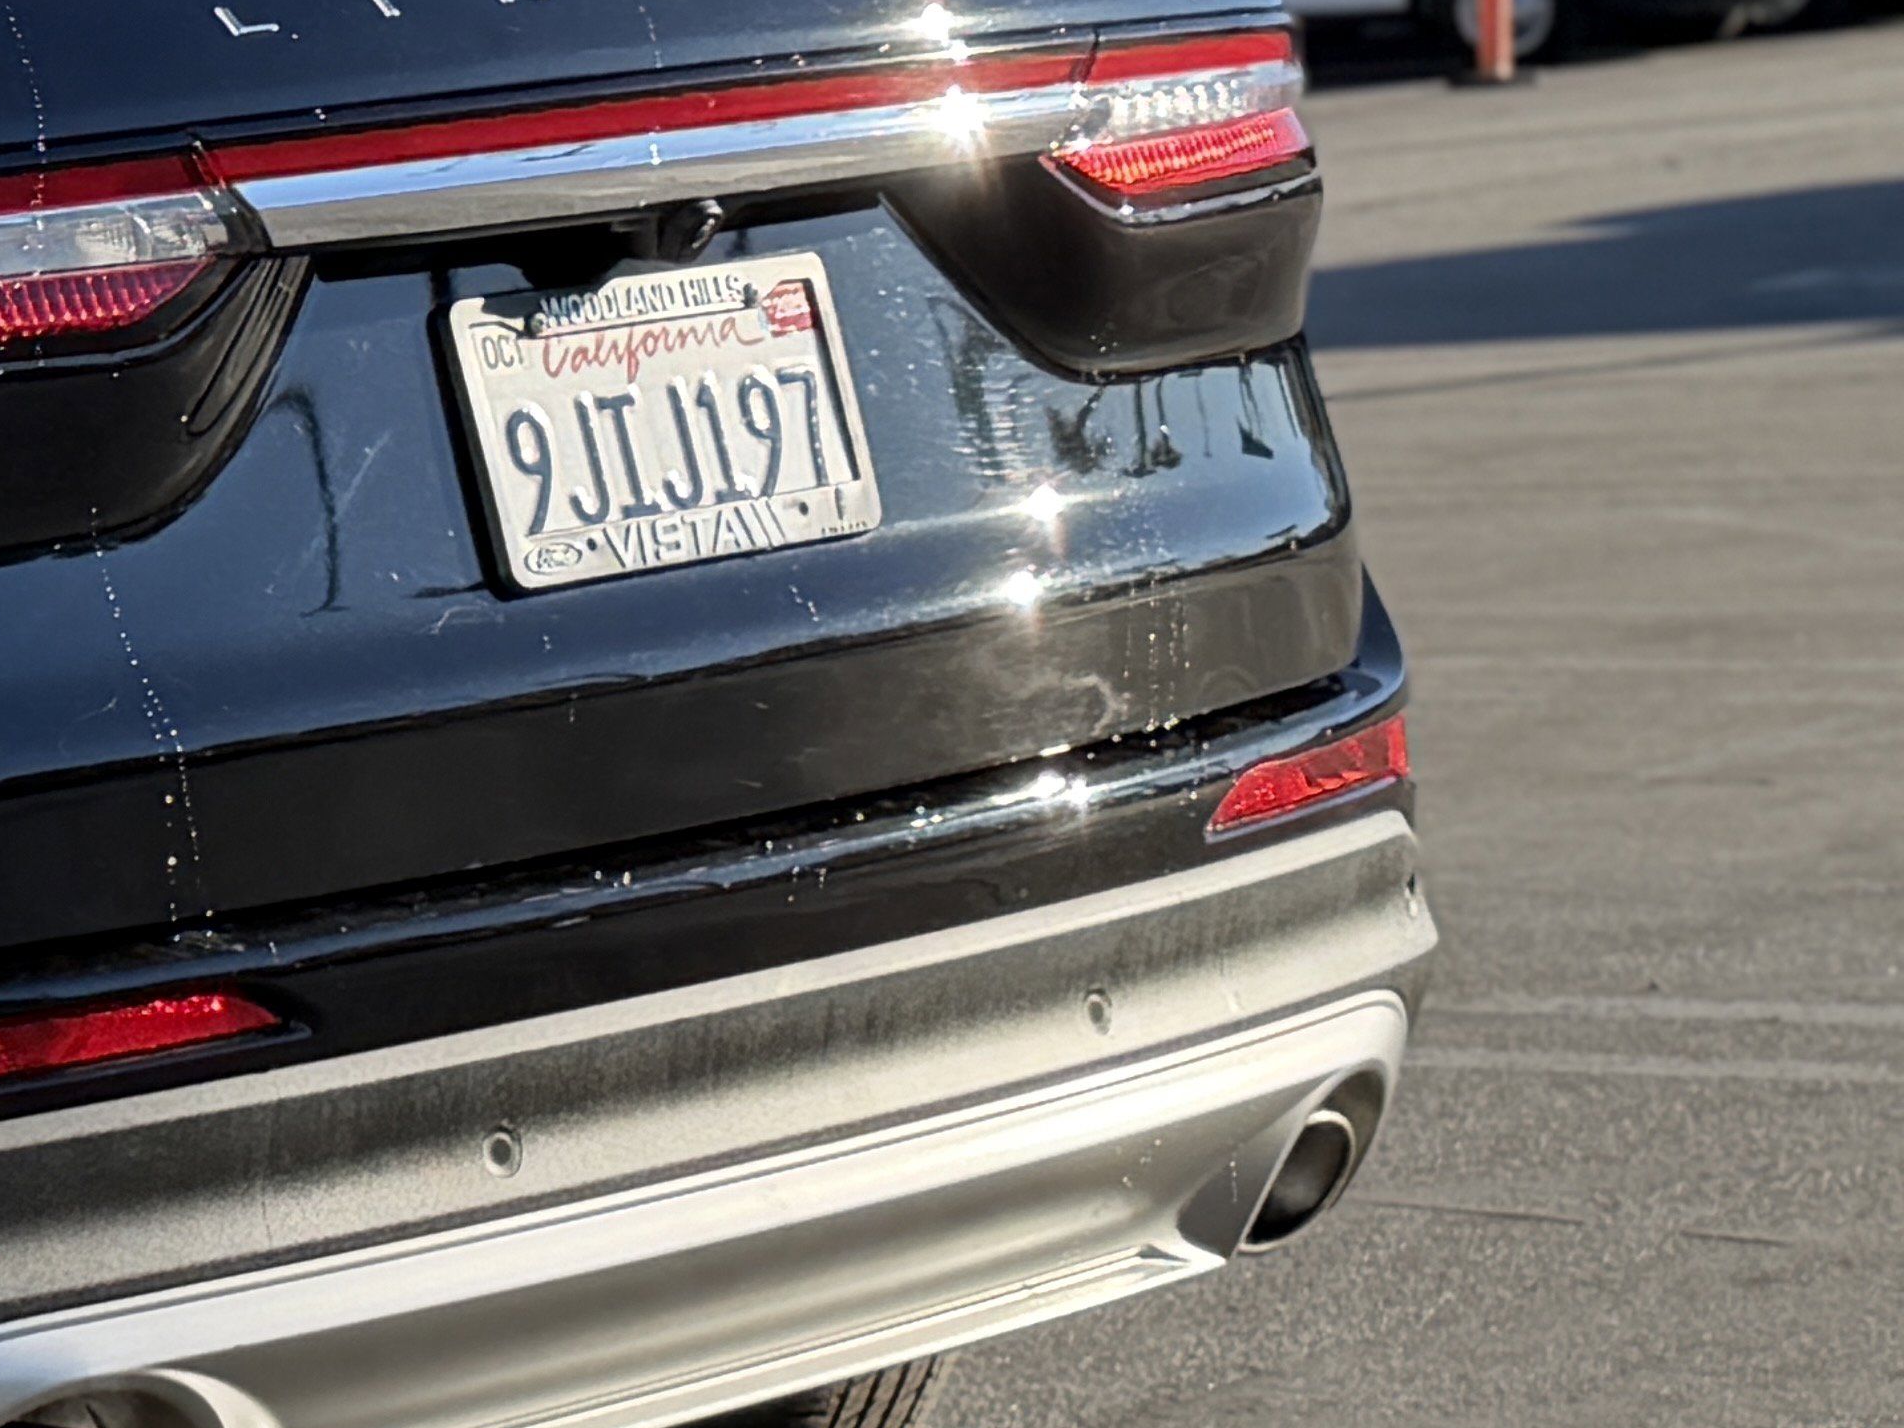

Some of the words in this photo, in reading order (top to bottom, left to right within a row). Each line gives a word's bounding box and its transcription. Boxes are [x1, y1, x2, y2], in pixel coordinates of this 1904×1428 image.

[541, 281, 677, 325] WOODLAND
[682, 273, 745, 308] HILLS
[542, 316, 766, 382] California
[505, 364, 830, 537] 9JIJ197
[600, 506, 757, 570] VISTA
